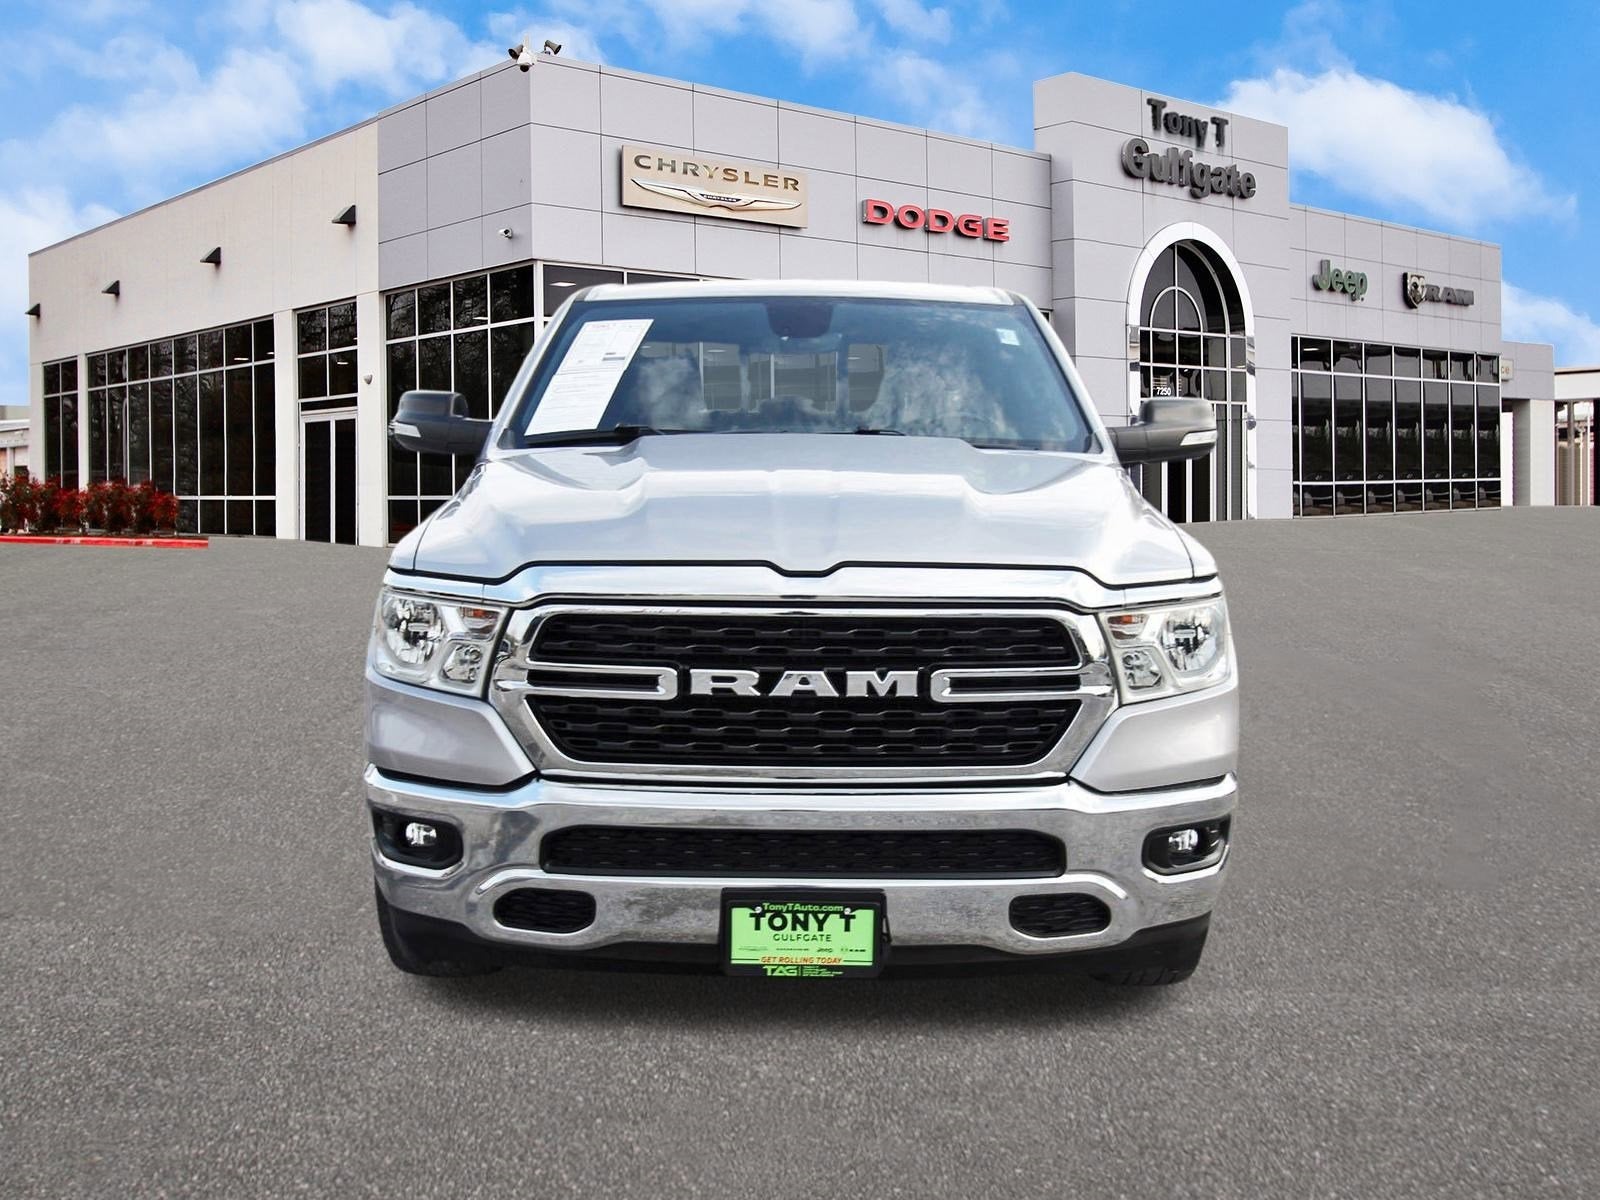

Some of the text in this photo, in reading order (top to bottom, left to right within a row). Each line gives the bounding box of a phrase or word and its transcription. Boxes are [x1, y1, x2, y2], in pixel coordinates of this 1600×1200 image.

[1146, 98, 1229, 147] Tony T
[632, 153, 801, 192] CHRYSLER
[1121, 137, 1257, 199] Gulfgate
[862, 198, 1010, 242] DODGE
[1313, 259, 1368, 300] Jeep
[1425, 283, 1475, 306] RAM
[689, 667, 919, 698] RAM
[762, 902, 844, 912] TonyTAuto.com
[749, 912, 856, 932] TONY T
[773, 933, 832, 942] GULFGATE
[762, 965, 798, 976] TAG
[779, 956, 814, 964] ROLLING
